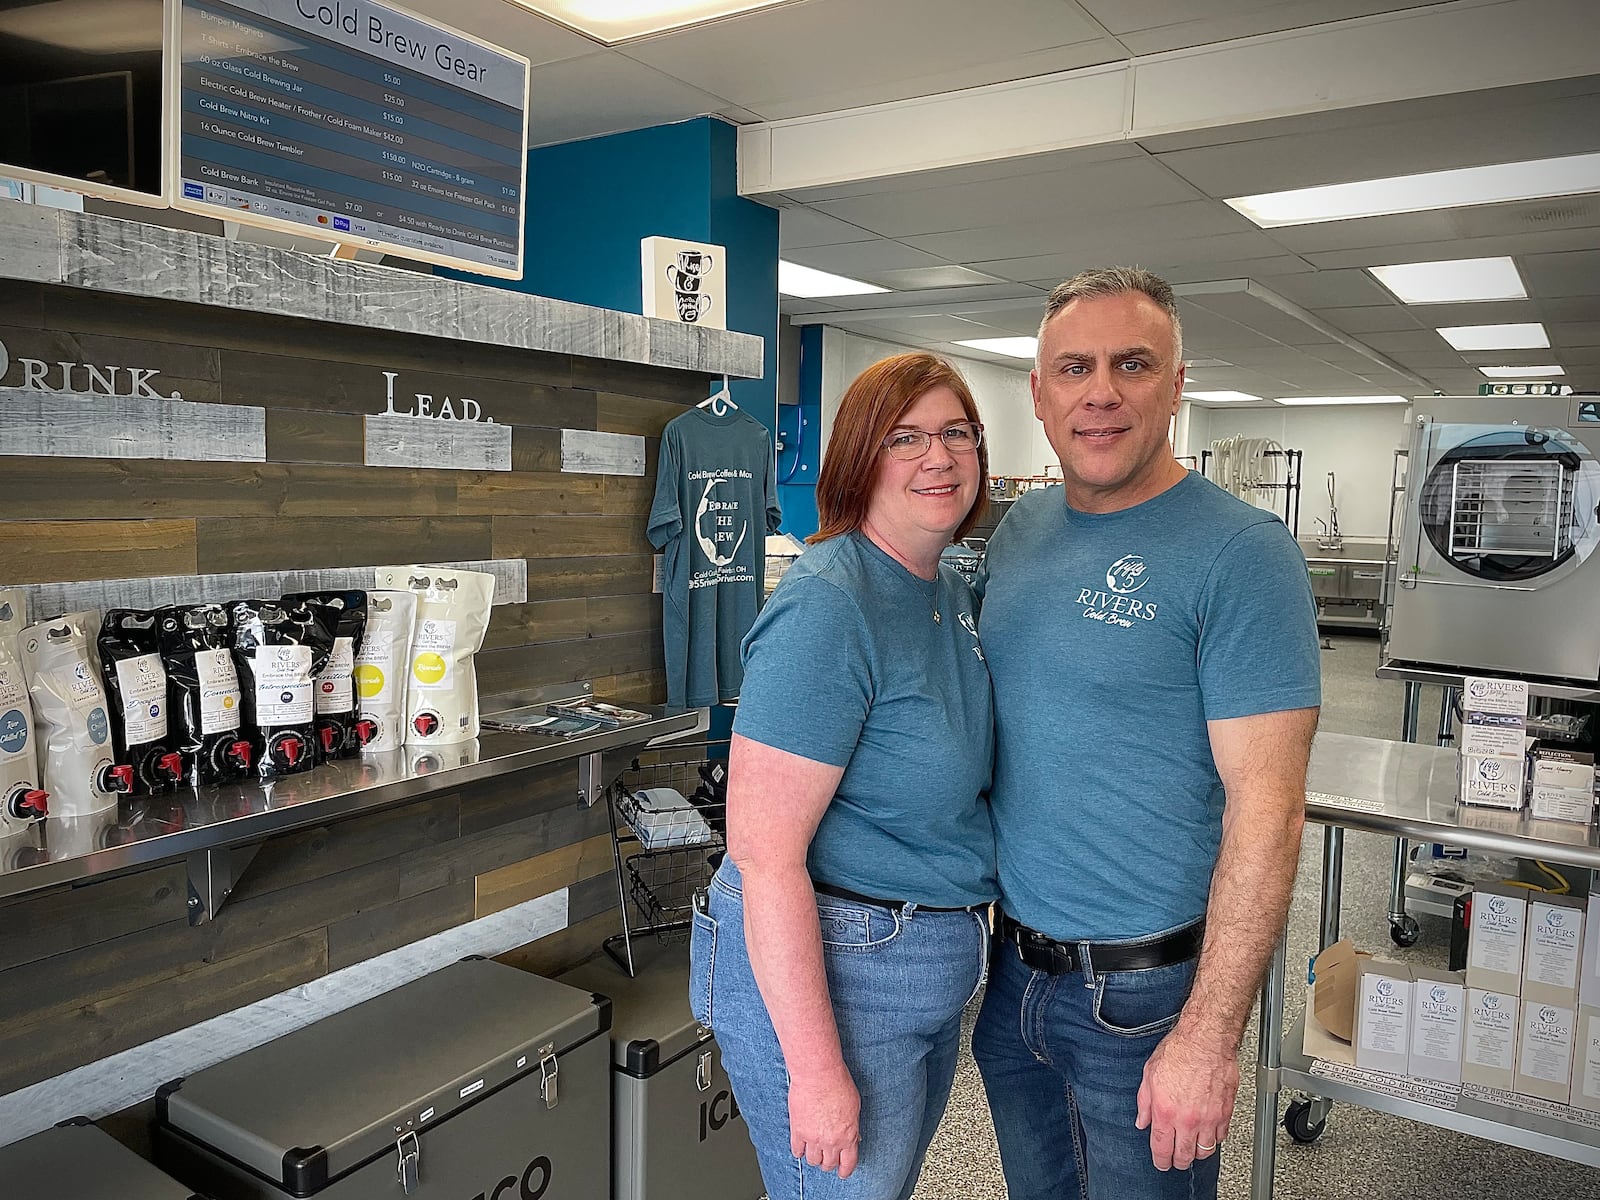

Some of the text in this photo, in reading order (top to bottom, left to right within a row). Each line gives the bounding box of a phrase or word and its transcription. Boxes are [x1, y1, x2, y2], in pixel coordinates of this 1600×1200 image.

[201, 10, 264, 39] Bumper Magnets
[296, 0, 486, 83] Cold Brew Gear
[208, 36, 229, 49] Shirts
[236, 44, 266, 61] Embrace
[268, 54, 280, 66] the
[281, 59, 299, 72] Brew
[200, 55, 303, 93] 60 oz Glass Cold Brewing Jar
[383, 73, 400, 86] $5.00
[383, 93, 405, 107] $25.00
[200, 76, 228, 92] Electric
[229, 85, 247, 98] Cold
[248, 91, 267, 104] Brew
[268, 97, 292, 111] Heater
[297, 106, 322, 120] Frother
[327, 115, 344, 127] Cold
[344, 120, 362, 132] Foam
[362, 125, 382, 138] Maker
[383, 132, 404, 145] $42.00
[200, 99, 270, 126] Cold Brew Nitro Kit
[382, 112, 404, 125] $15.00
[200, 122, 304, 156] 16 Ounce Cold Brew Tumbler
[382, 150, 406, 165] $150.00
[201, 165, 259, 187] Cold Brew Bank
[382, 171, 402, 183] $15.00
[426, 164, 452, 181] Cartridge
[460, 176, 475, 186] gram
[411, 180, 419, 189] 32
[454, 192, 473, 203] Freezer
[474, 197, 484, 206] Gel
[484, 200, 496, 210] Pack
[502, 186, 516, 198] $1.00
[501, 205, 516, 215] $1.00
[345, 202, 363, 212] $7.00
[398, 215, 415, 225] $4.50
[415, 219, 428, 228] with
[428, 222, 445, 233] Ready
[452, 228, 467, 238] Drink
[0, 339, 183, 401] RINK.
[1114, 560, 1148, 577] fifty
[1122, 573, 1135, 589] 5
[1075, 587, 1158, 622] RIVERS
[1082, 607, 1136, 629] Cold Brew
[1487, 682, 1524, 692] RIVERS
[1469, 780, 1516, 793] RIVERS
[1480, 912, 1517, 925] RIVERS
[1537, 925, 1576, 938] RIVERS
[1368, 995, 1404, 1006] RIVERS
[1422, 1001, 1458, 1013] RIVERS
[1473, 1007, 1511, 1020] RIVERS
[1530, 1021, 1568, 1035] RIVERS
[1314, 1061, 1330, 1070] Life
[1341, 1067, 1365, 1079] Hard,
[1368, 1073, 1397, 1086] COLD
[1398, 1080, 1427, 1094] BREW
[1429, 1088, 1457, 1103] Helps
[1329, 1072, 1392, 1092] 55rivers.com
[1407, 1092, 1456, 1108] @55rivers
[1413, 1077, 1461, 1092] @55rivers
[1465, 1082, 1489, 1094] COLD
[1490, 1088, 1514, 1098] BREW
[1515, 1093, 1548, 1107] Because
[1549, 1103, 1583, 1118] Adulting
